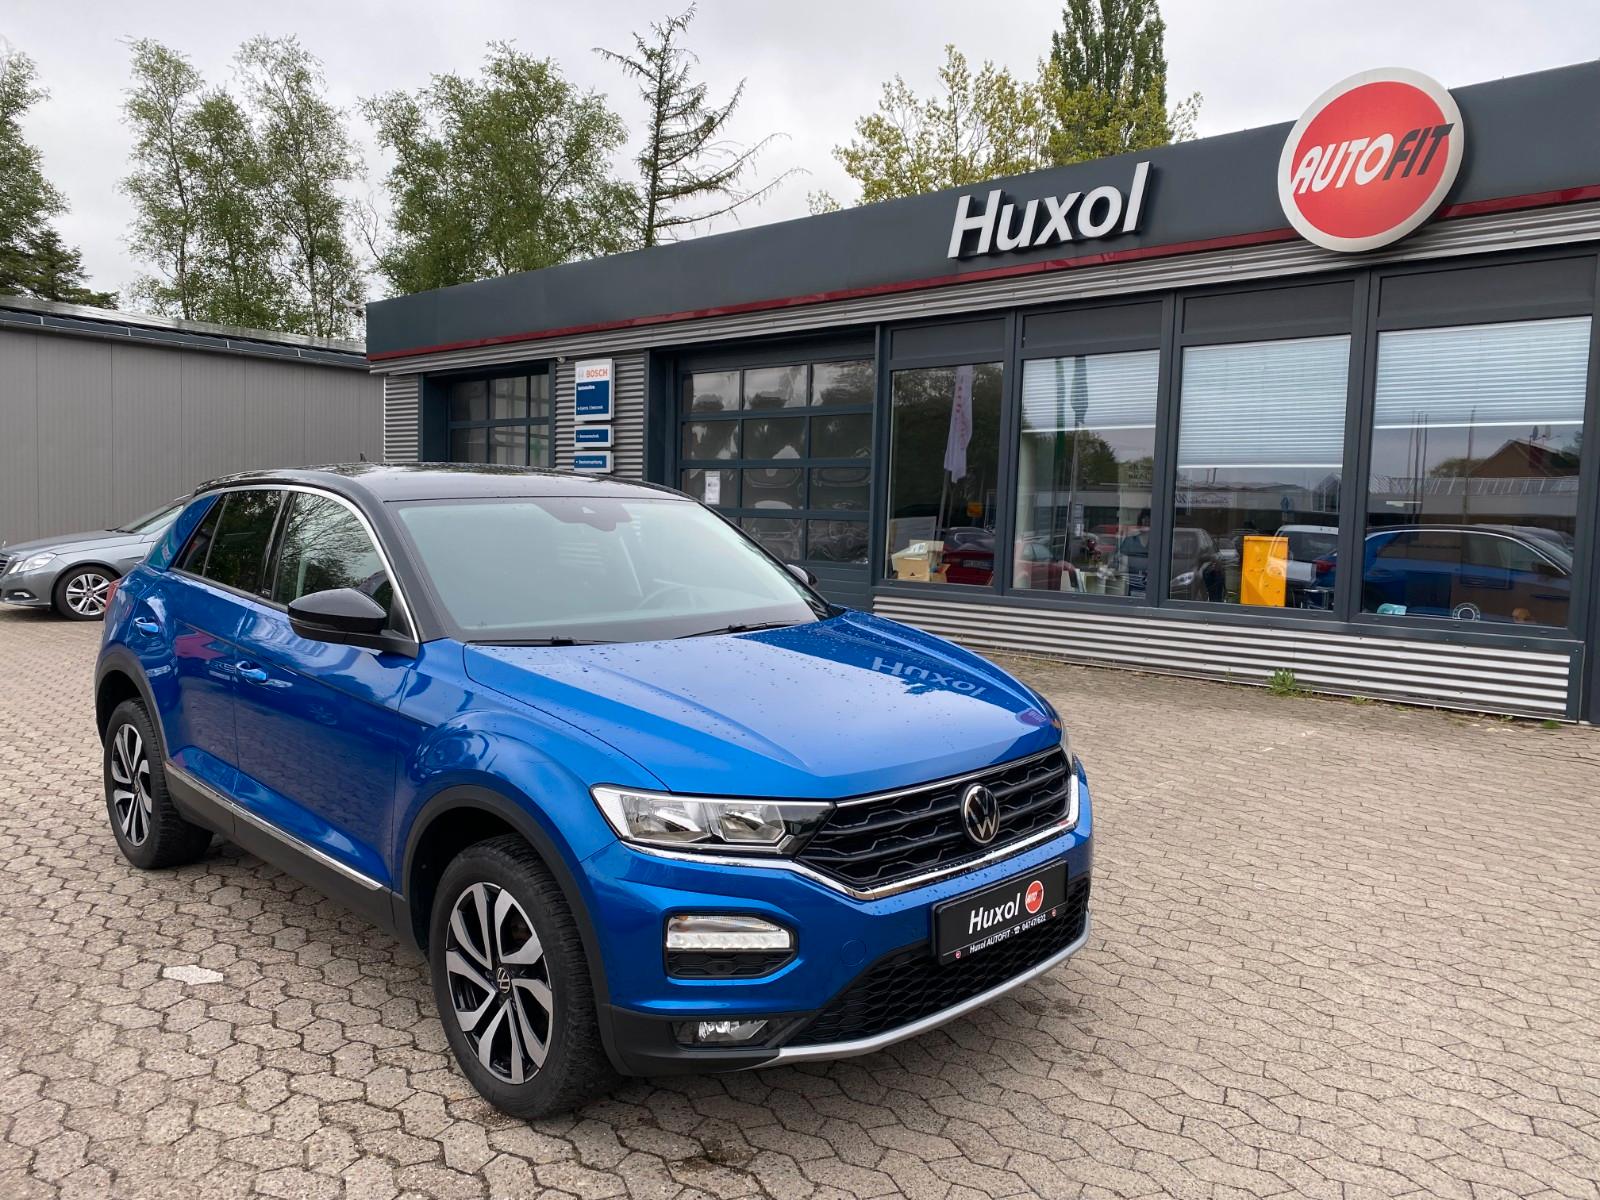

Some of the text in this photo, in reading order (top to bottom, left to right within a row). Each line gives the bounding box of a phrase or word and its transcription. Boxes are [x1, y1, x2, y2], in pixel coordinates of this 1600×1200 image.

[1291, 123, 1454, 194] AUTOFIT
[947, 161, 1152, 259] Huxol
[586, 367, 608, 378] BOSCH
[968, 893, 1020, 934] Huxol
